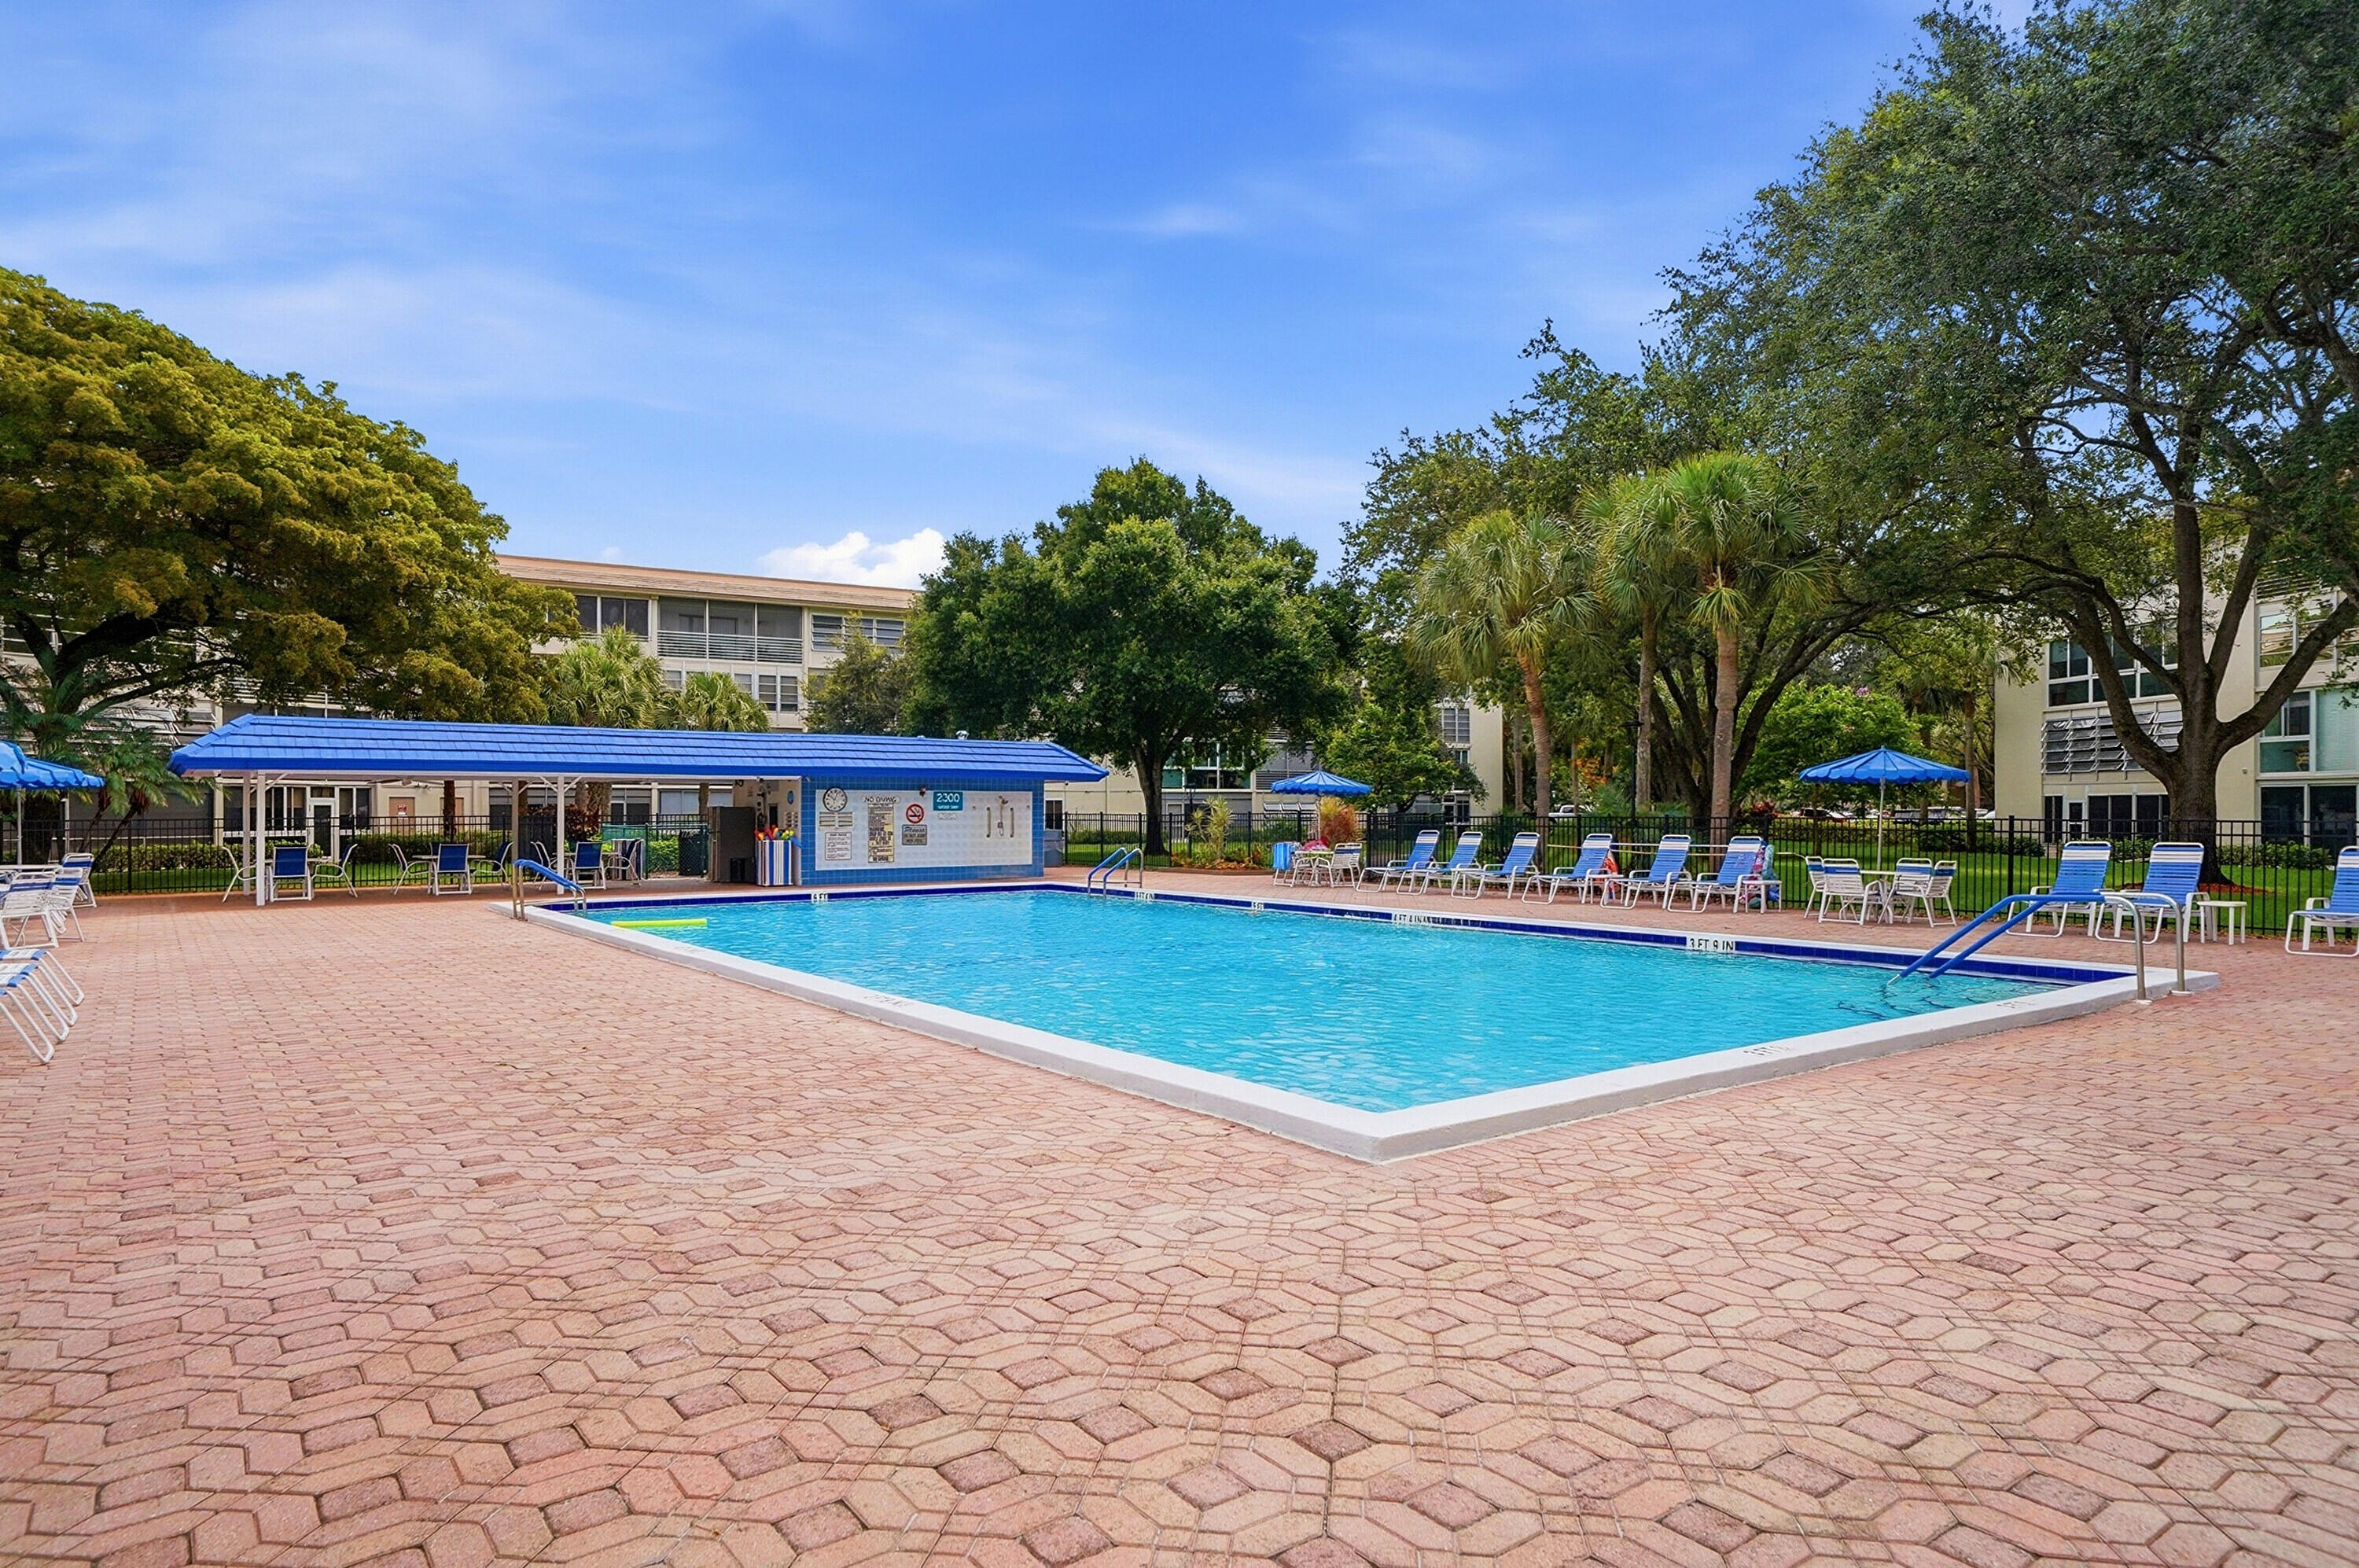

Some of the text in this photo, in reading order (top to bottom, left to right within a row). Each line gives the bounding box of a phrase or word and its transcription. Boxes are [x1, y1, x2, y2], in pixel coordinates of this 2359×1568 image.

[937, 793, 959, 802] 2300
[1690, 938, 1695, 948] 3
[1698, 939, 1709, 950] FT
[1722, 940, 1734, 951] IN
